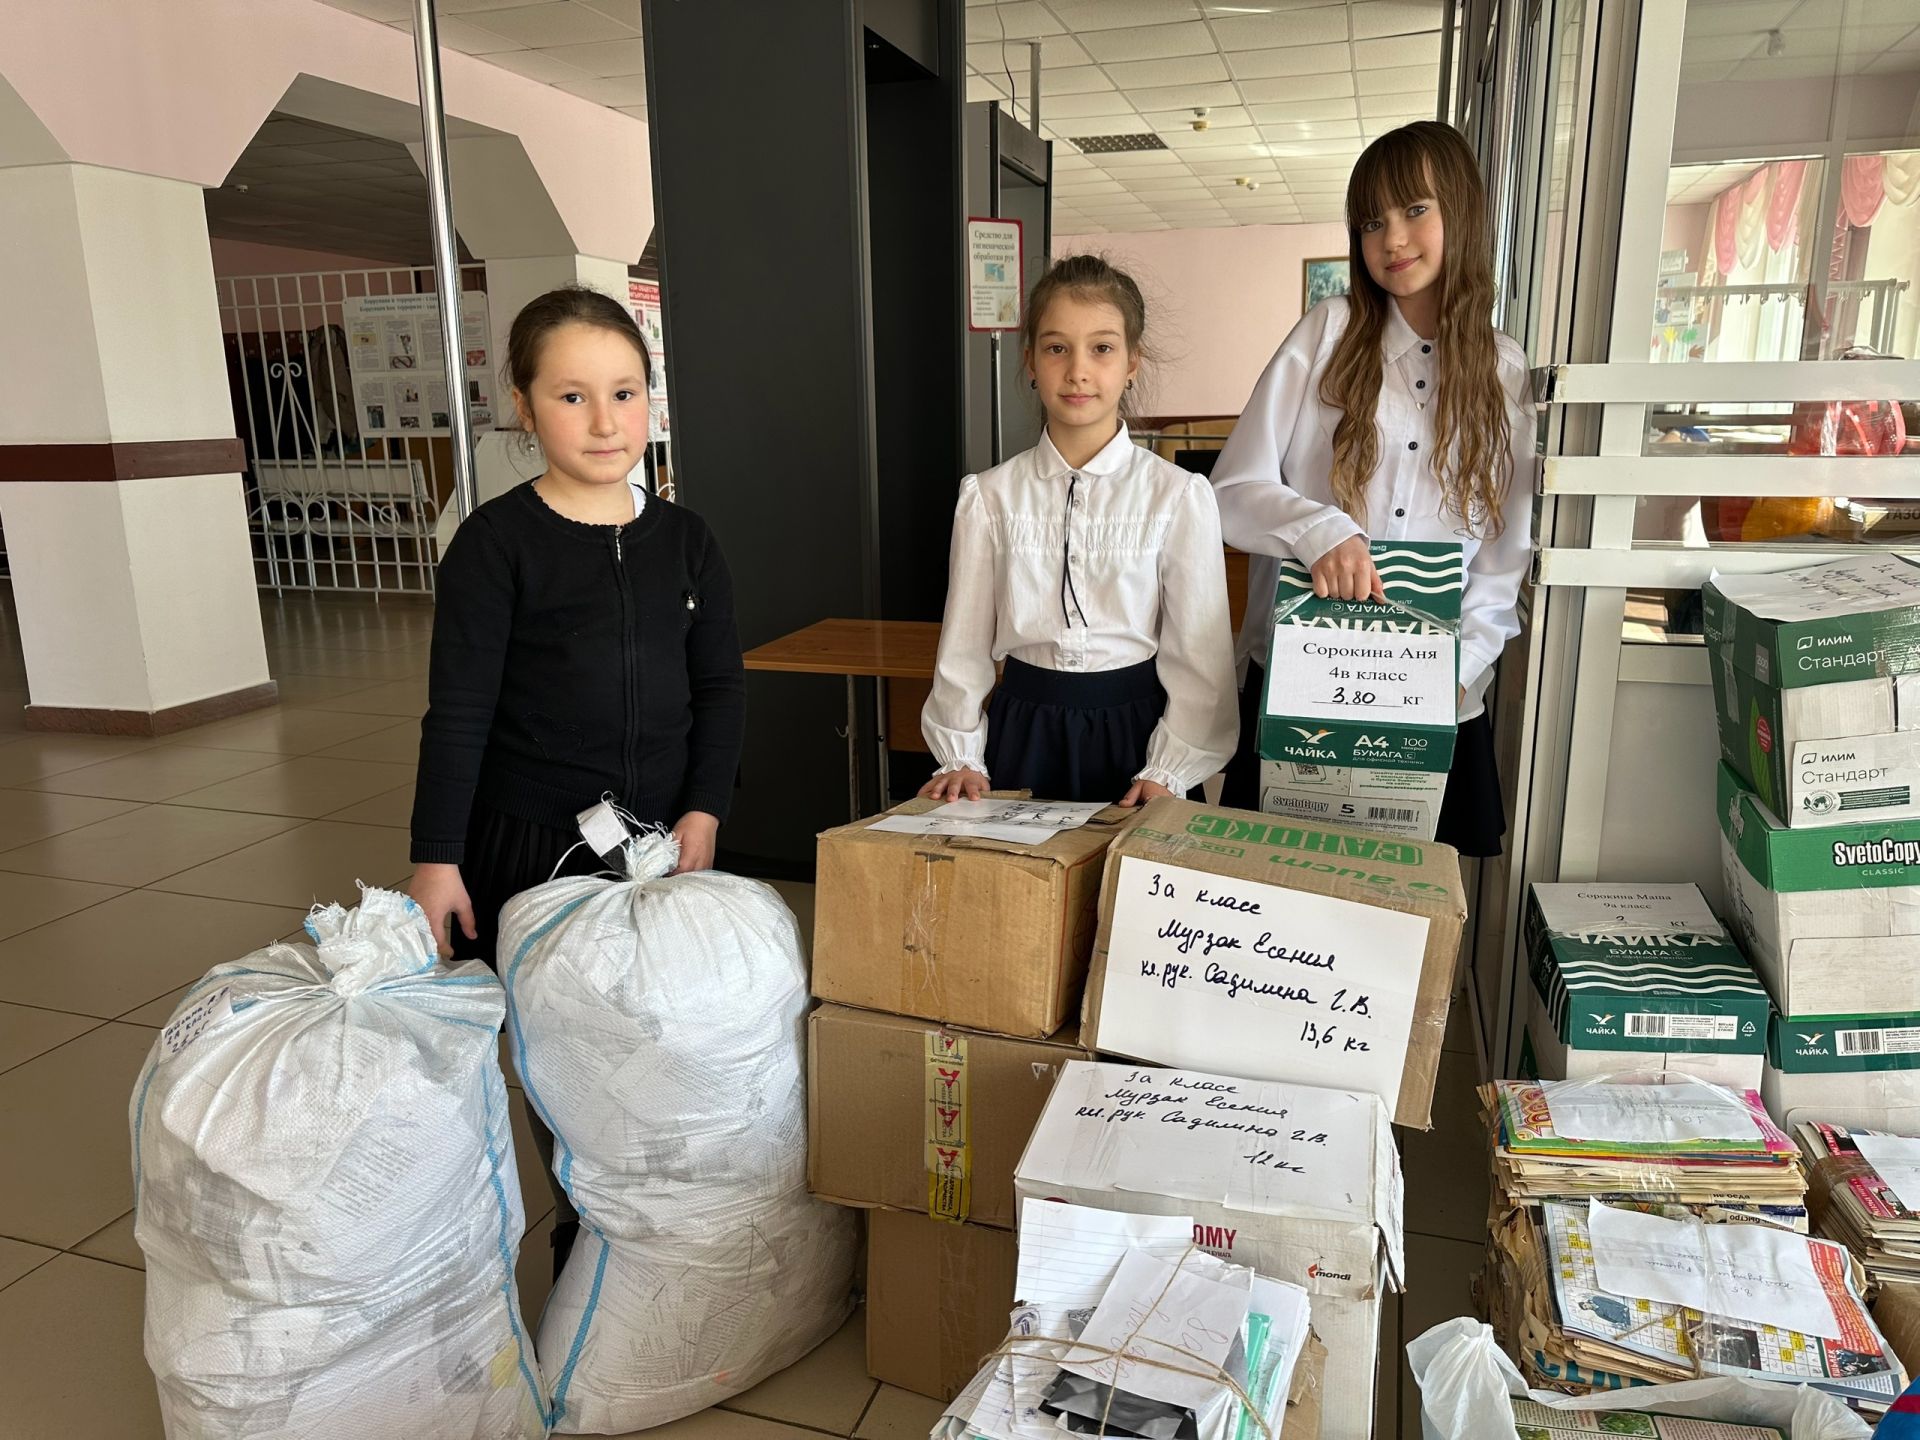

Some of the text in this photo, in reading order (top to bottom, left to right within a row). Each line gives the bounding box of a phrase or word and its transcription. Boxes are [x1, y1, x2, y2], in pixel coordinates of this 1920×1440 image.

[1303, 642, 1438, 660] Сорокина Аня
[1798, 649, 1887, 672] Стандарт
[1328, 667, 1408, 682] 4в класс
[1403, 695, 1424, 706] кг
[1403, 737, 1428, 747] 100
[1284, 745, 1337, 760] ЧАЙКА
[1353, 749, 1402, 759] БУМАГА
[1801, 767, 1889, 785] Стандарт
[1273, 795, 1355, 814] SvetoCopy 5
[1832, 837, 1920, 867] SvetoCopy
[1862, 867, 1905, 876] CLASSIC
[1195, 889, 1263, 916] класс
[1577, 892, 1634, 901] Сорокина
[1252, 932, 1337, 973] Есения
[1609, 948, 1671, 956] БУМАГА
[1586, 1026, 1617, 1035] ЧАЙКА
[1343, 1036, 1371, 1052] кг
[1795, 1047, 1829, 1056] ЧАЙКА
[1169, 1076, 1241, 1094] класс
[1315, 1269, 1352, 1281] mondi
